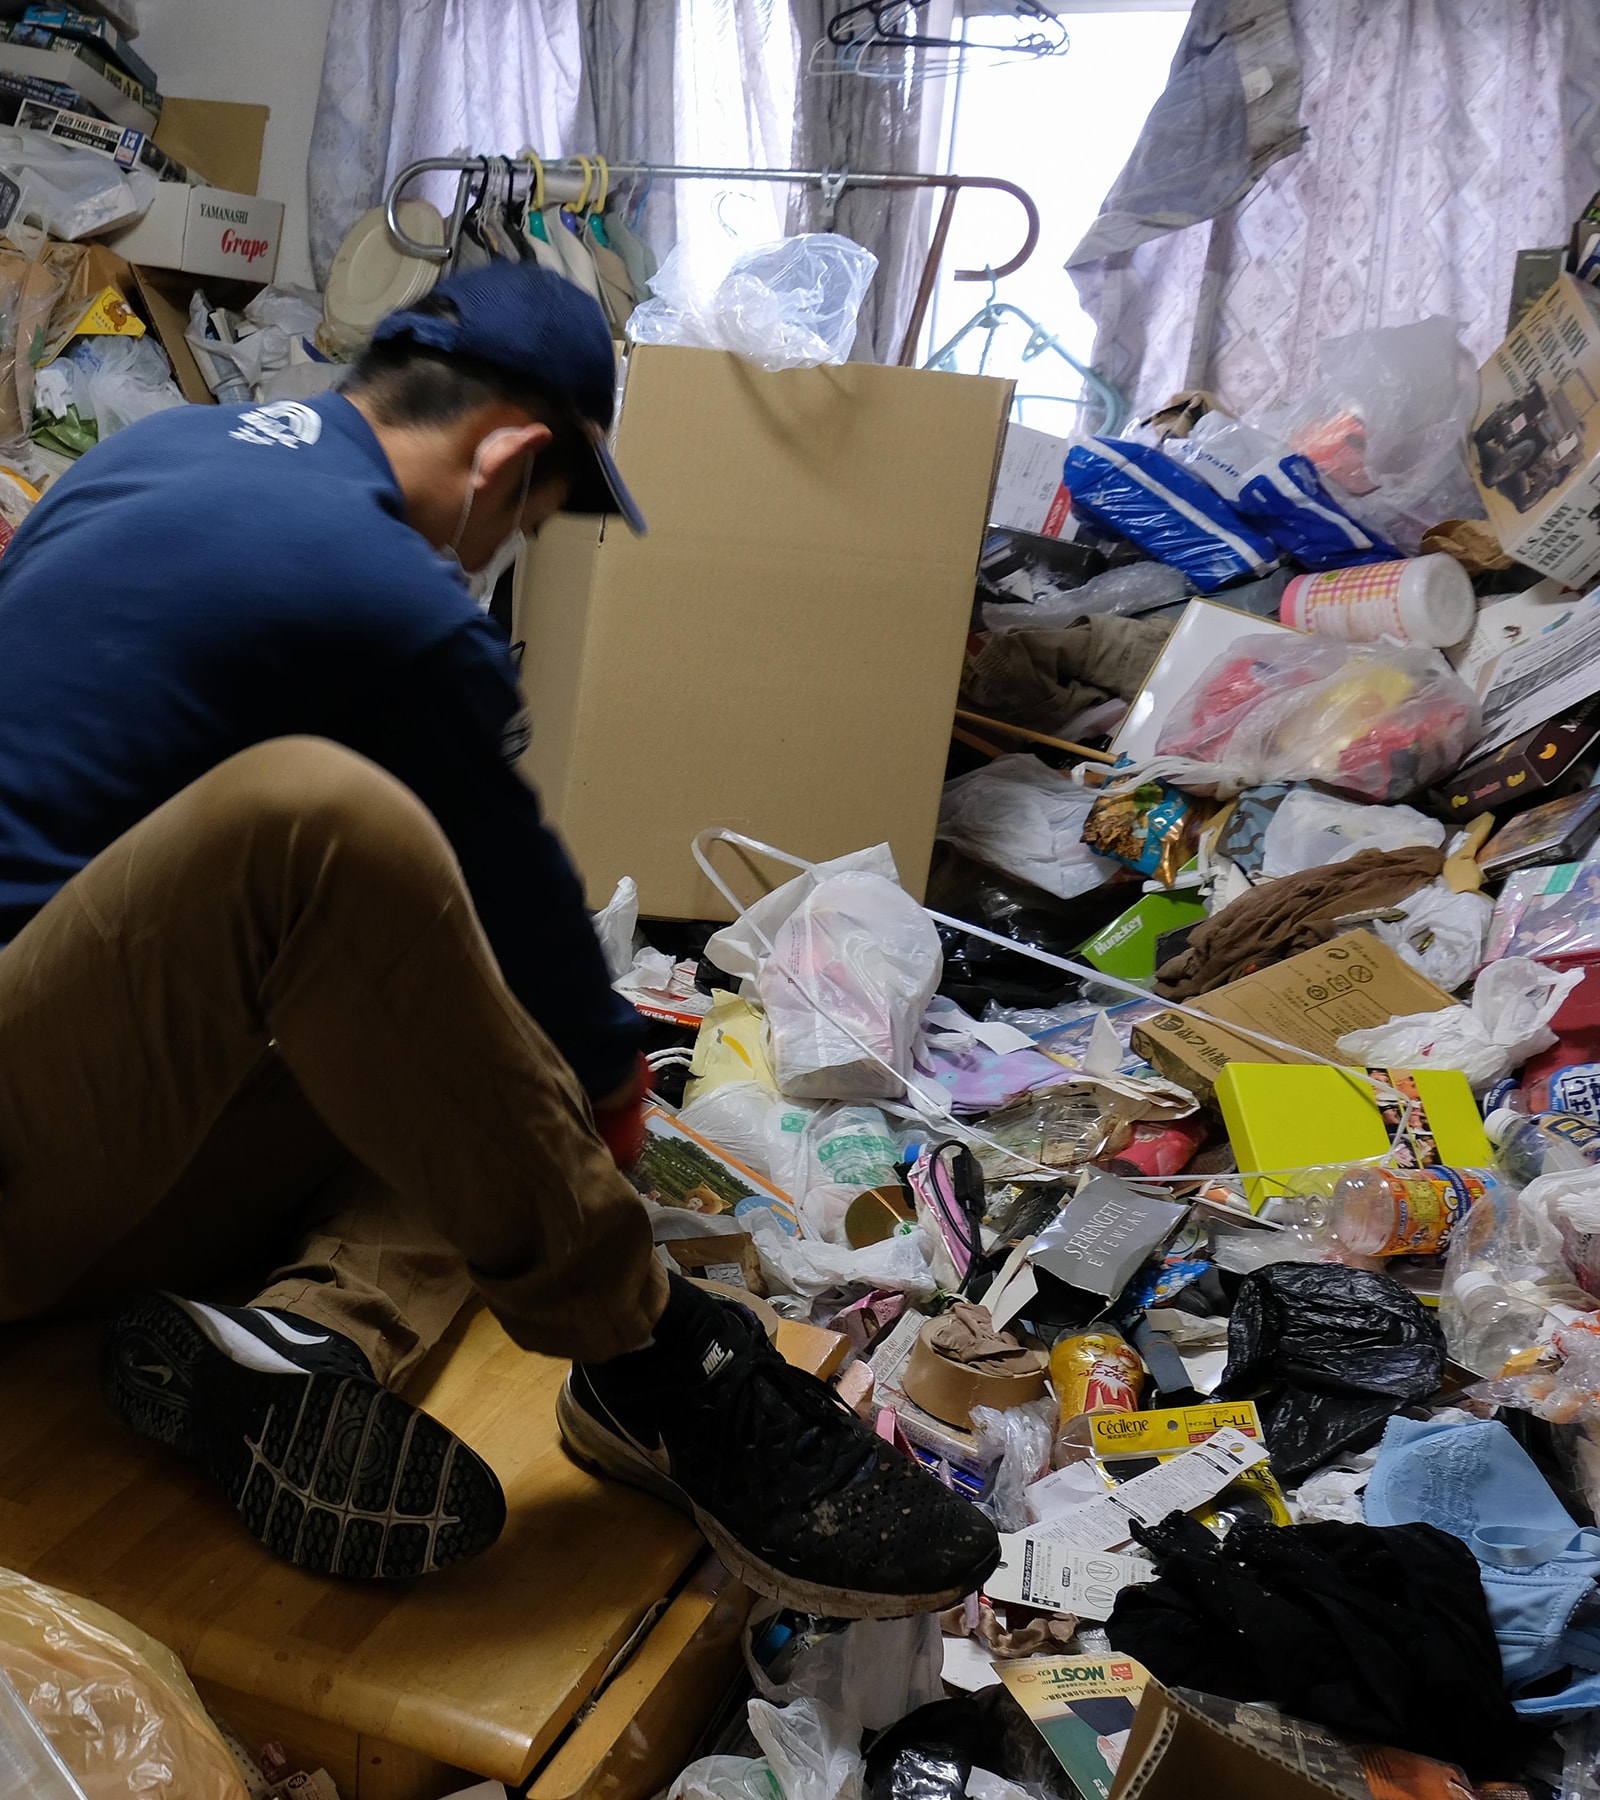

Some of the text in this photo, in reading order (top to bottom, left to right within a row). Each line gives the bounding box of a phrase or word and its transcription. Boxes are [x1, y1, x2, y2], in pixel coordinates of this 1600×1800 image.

[102, 125, 122, 140] TRUCK
[200, 203, 249, 224] YAMANASHI
[221, 228, 268, 263] Grape
[1560, 314, 1590, 358] ARMY
[1508, 330, 1545, 382] TRUCK
[1540, 504, 1572, 533] ARMY
[1538, 532, 1580, 566] TRUCK
[1094, 914, 1144, 956] Huntkey
[1064, 1200, 1128, 1260] SERENGETI
[1087, 1210, 1148, 1267] EYEWEAR
[702, 1342, 725, 1375] NIKE
[1097, 1418, 1150, 1436] Cécilene
[1052, 1665, 1106, 1684] MOST
